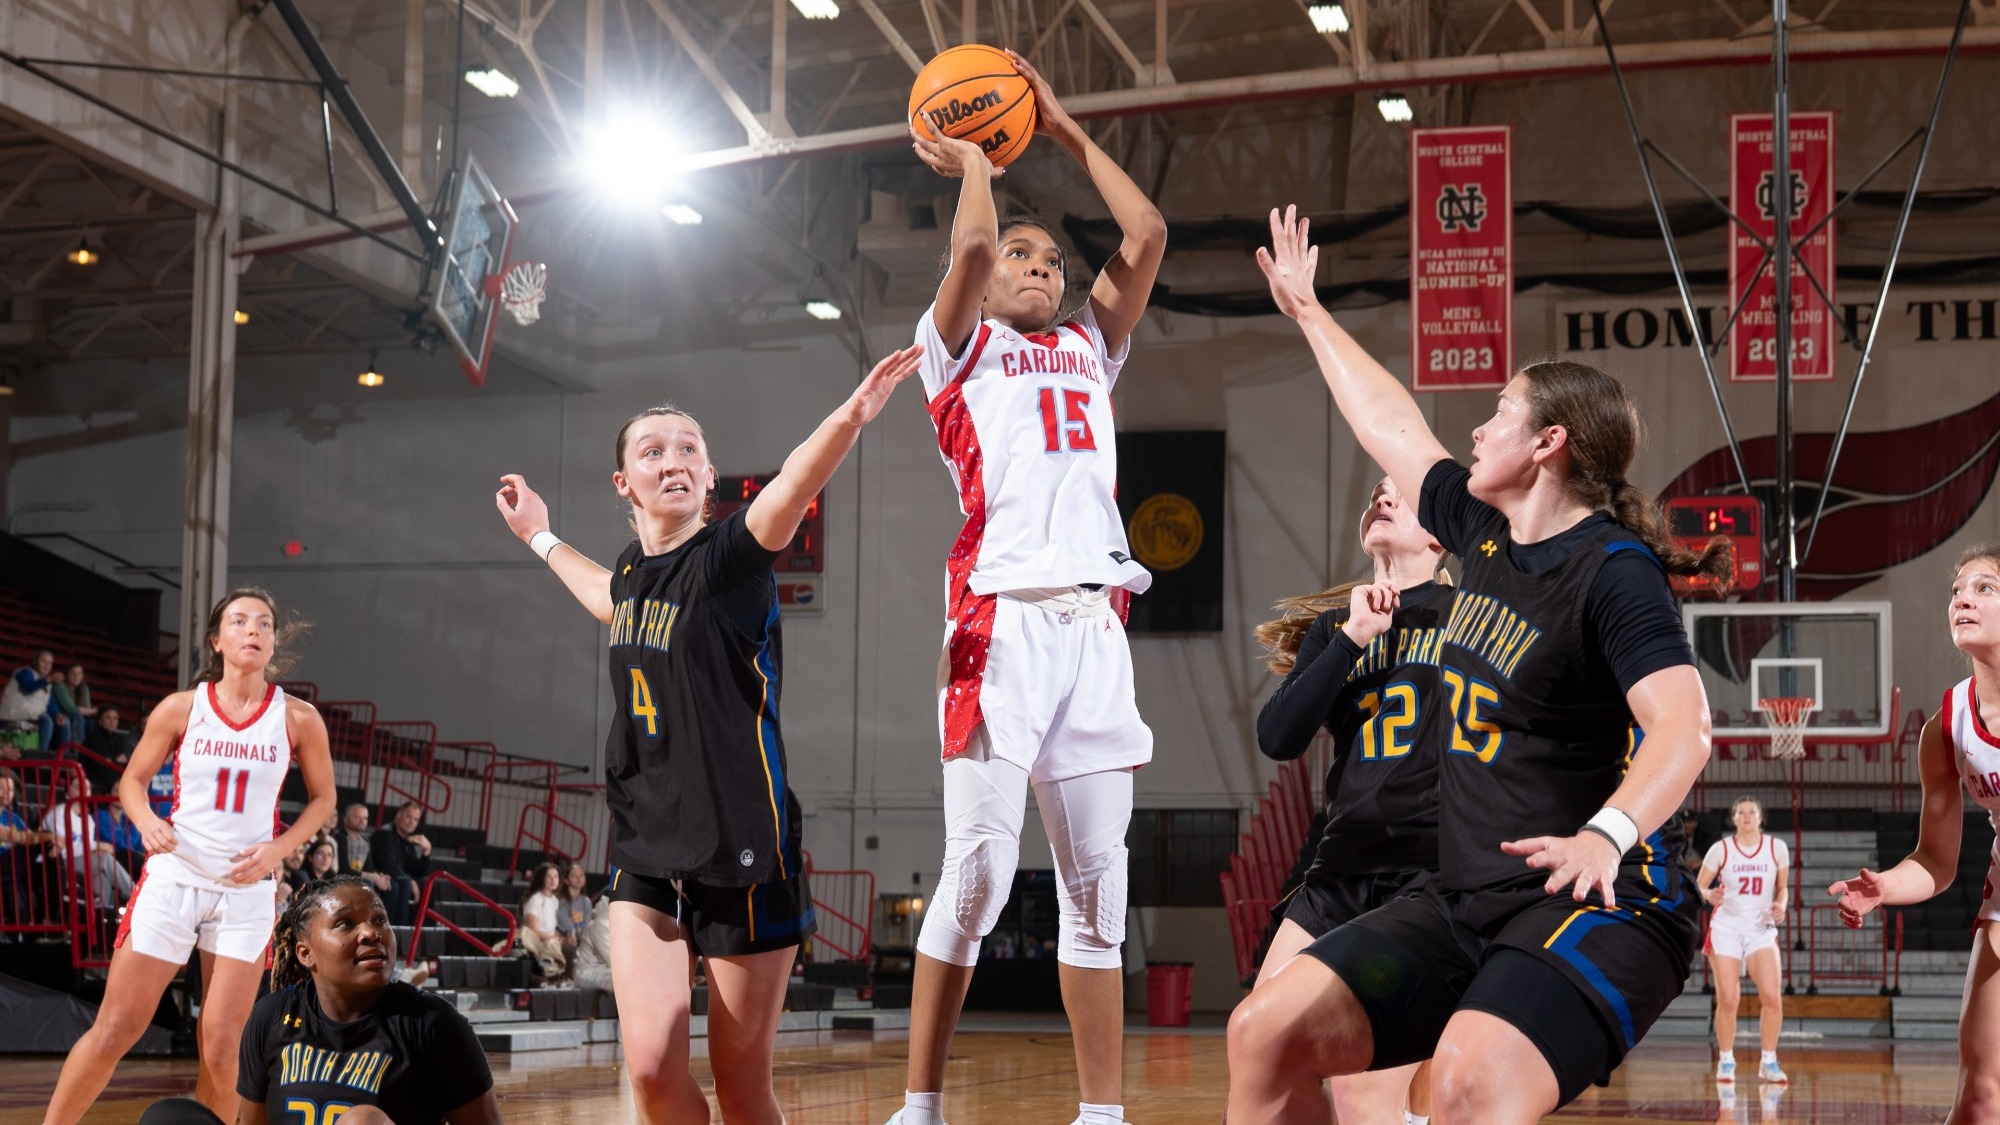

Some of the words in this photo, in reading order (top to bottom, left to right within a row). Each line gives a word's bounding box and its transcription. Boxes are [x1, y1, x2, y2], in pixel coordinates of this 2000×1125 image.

[1418, 145, 1453, 157] NORTH
[1456, 143, 1504, 155] CENTRAL
[1439, 156, 1483, 167] COLLEGE
[1420, 249, 1444, 259] NCAA
[1446, 247, 1489, 257] DIVISION
[1492, 246, 1504, 256] III
[1426, 259, 1498, 274] NATIONAL
[1418, 273, 1505, 290] RUNNER-UP
[1442, 306, 1481, 319] MEN'S
[1422, 320, 1502, 335] VOLLEYBALL
[1000, 347, 1101, 386] CARDINALS
[1429, 346, 1494, 372] 2023
[1036, 385, 1099, 454] 15
[637, 597, 681, 653] PARK
[1444, 588, 1500, 652] NORTH
[1478, 602, 1543, 681] PARK
[627, 664, 660, 738] 4
[1355, 680, 1420, 762] 12
[1443, 664, 1507, 768] 25
[193, 737, 279, 764] CARDINALS
[214, 765, 252, 816] 11
[1732, 862, 1770, 874] CARDINALS
[1738, 875, 1764, 896] 20
[280, 1041, 341, 1087] NORTH
[335, 1050, 395, 1096] PARK
